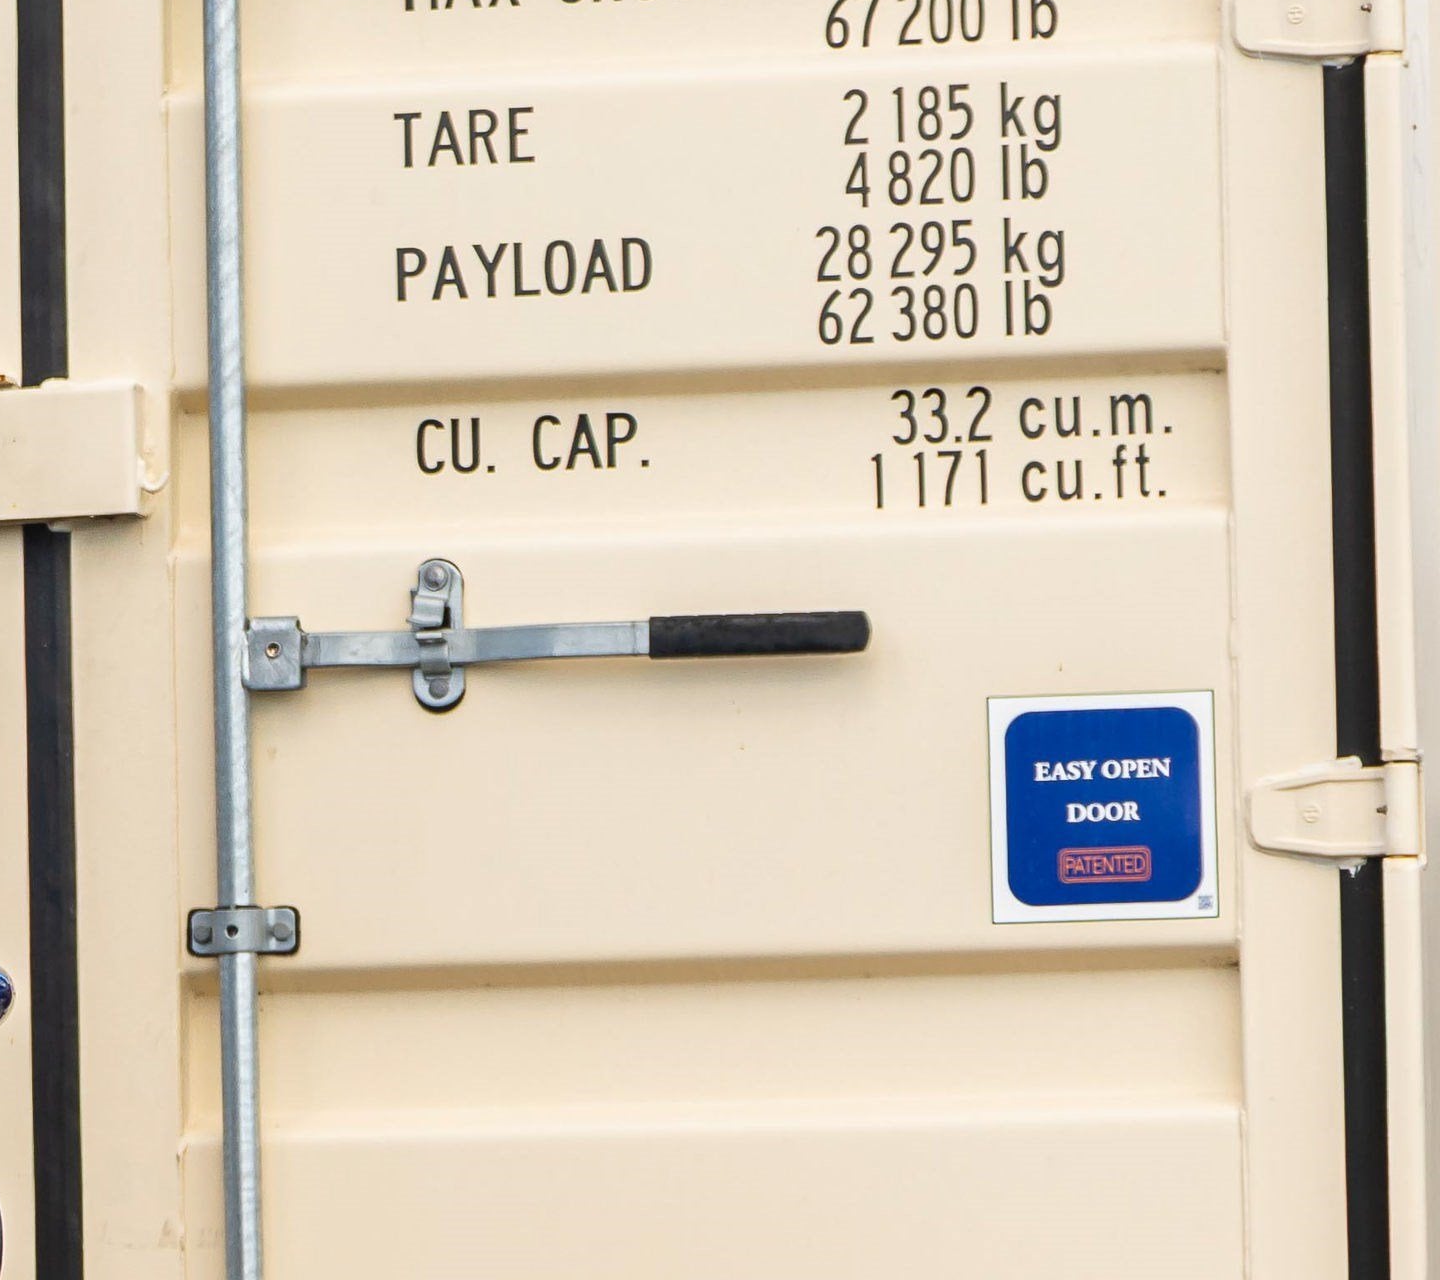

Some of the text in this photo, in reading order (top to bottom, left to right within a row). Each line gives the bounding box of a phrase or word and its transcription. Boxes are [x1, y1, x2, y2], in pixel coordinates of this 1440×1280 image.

[393, 106, 535, 169] TARE
[843, 81, 1061, 153] 2 185 kg
[845, 139, 1053, 208] 4 820 lb
[395, 237, 652, 302] PAYLOAD
[815, 217, 1065, 289] 28 295 kg
[818, 277, 1057, 345] 62 380 lb
[416, 412, 650, 475] CU. CAP.
[890, 385, 1172, 446] 33.2 cu.m.
[870, 443, 1166, 509] 1 171 cu.ft.
[1033, 757, 1172, 782] EASY OPEN
[1065, 801, 1141, 824] DOOR
[1065, 853, 1147, 877] PATENTED
